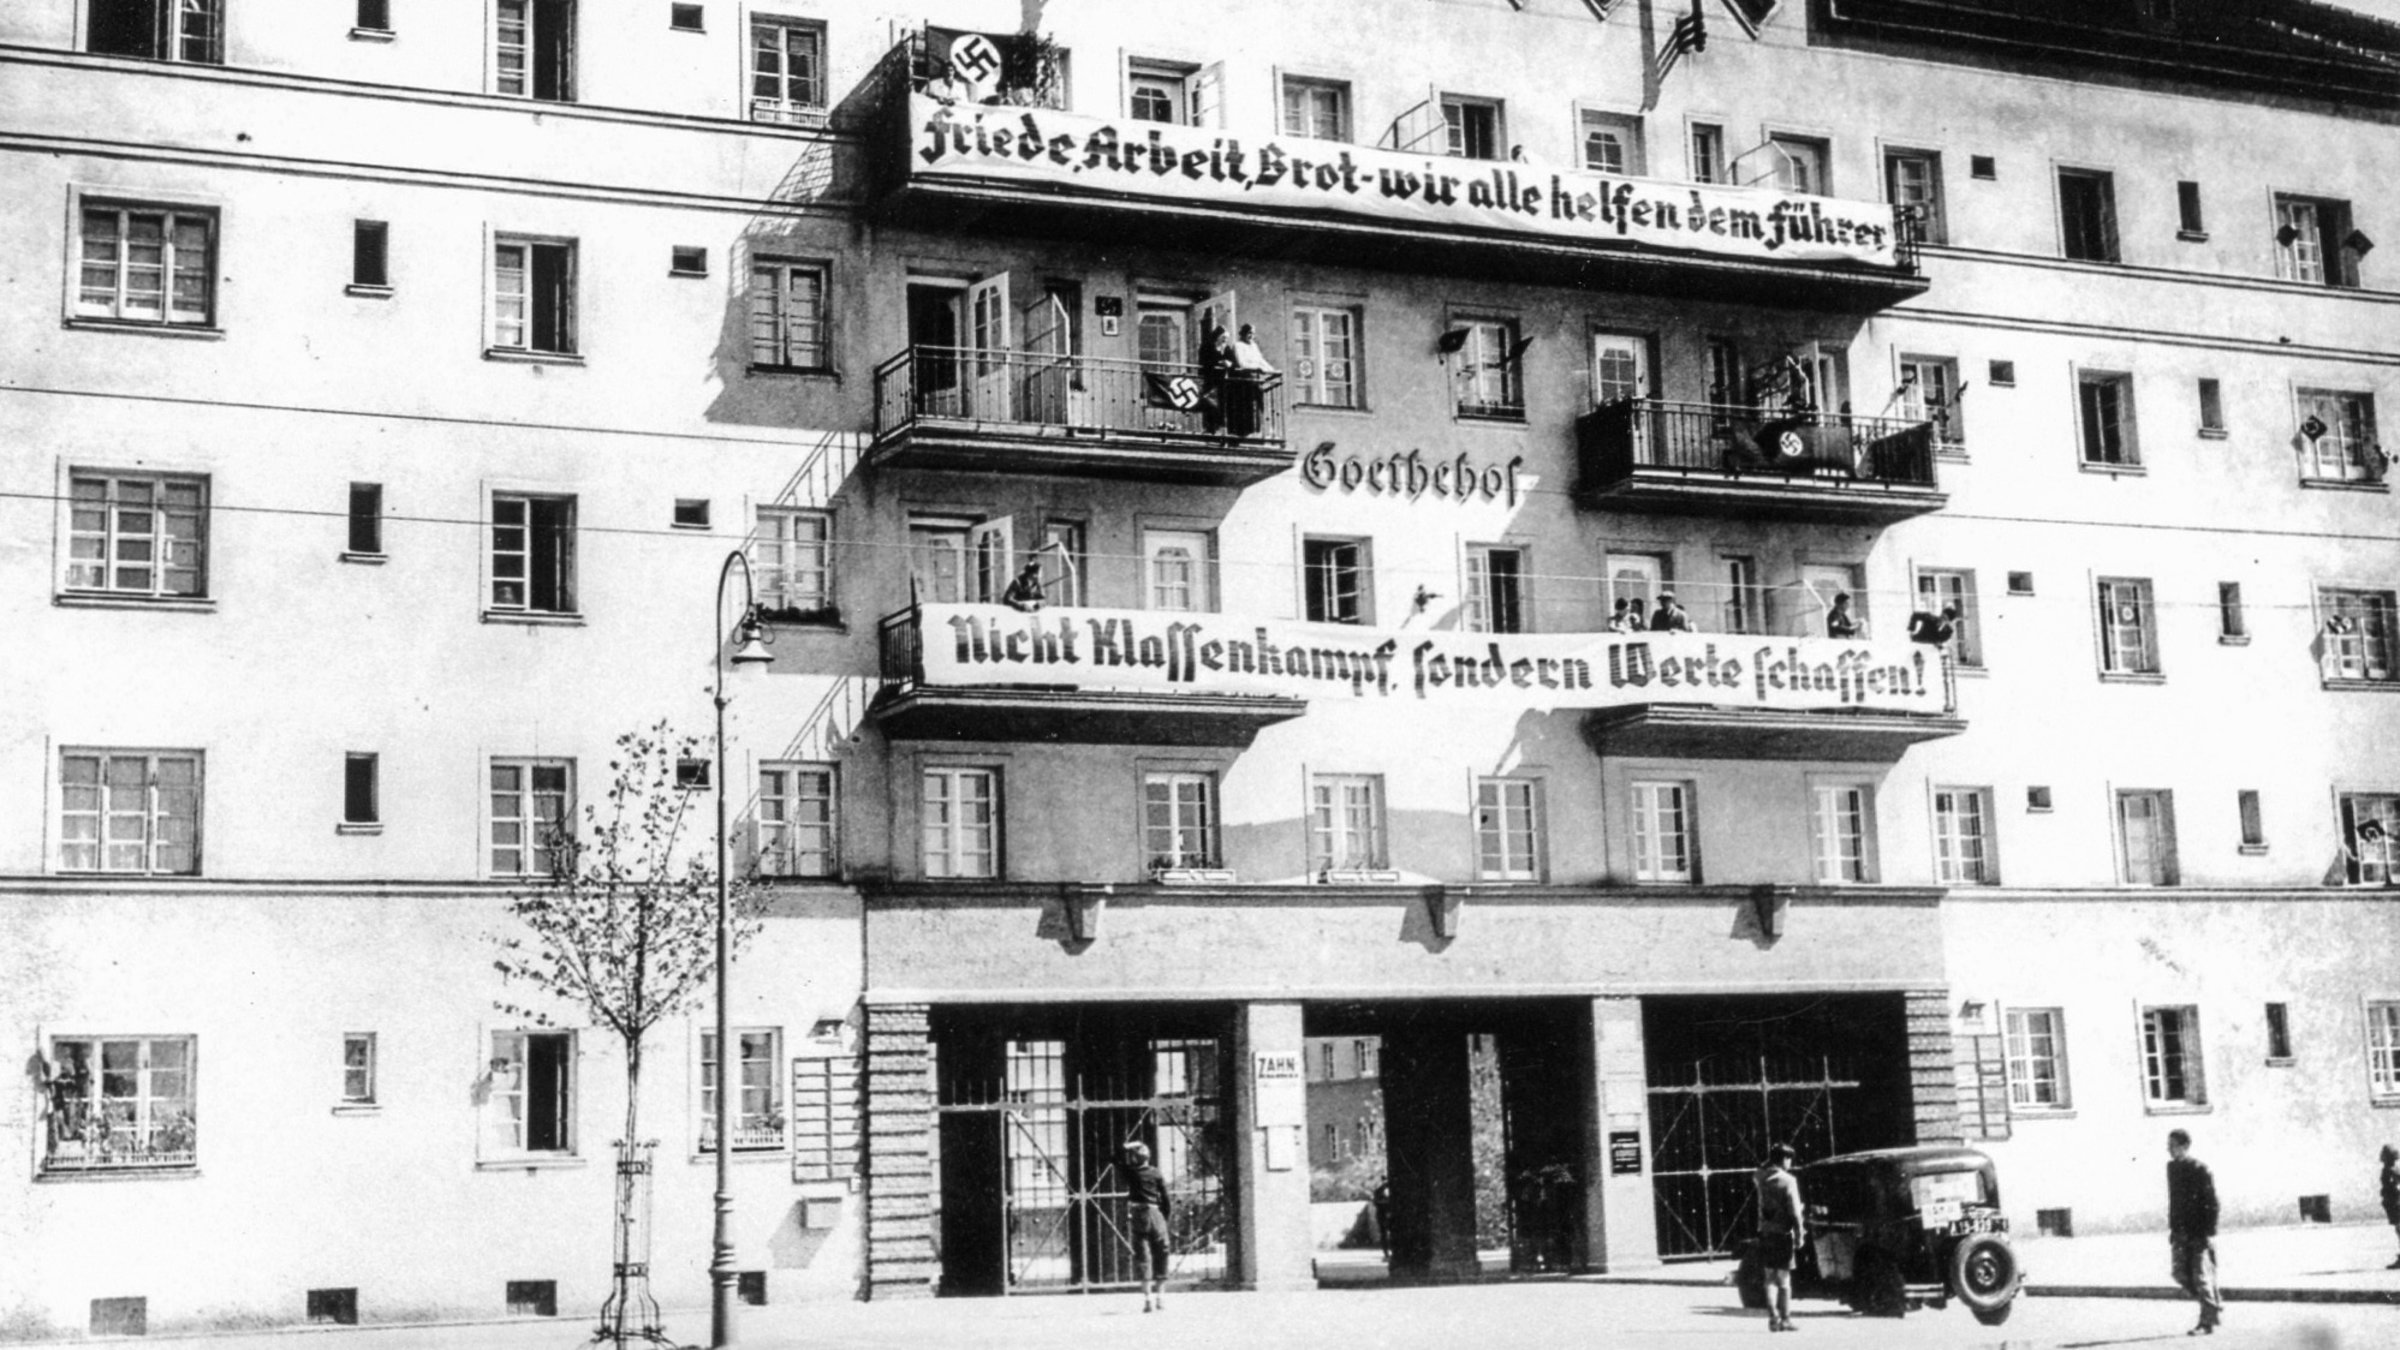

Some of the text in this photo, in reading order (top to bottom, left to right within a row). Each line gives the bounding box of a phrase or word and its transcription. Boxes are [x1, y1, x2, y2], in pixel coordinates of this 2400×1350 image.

[1468, 168, 1543, 217] alle
[1551, 174, 1682, 235] helfen
[1687, 190, 1765, 240] dem
[1303, 441, 1524, 508] Goethehof
[947, 614, 1081, 665] Nicht
[1607, 642, 1742, 690] Werte
